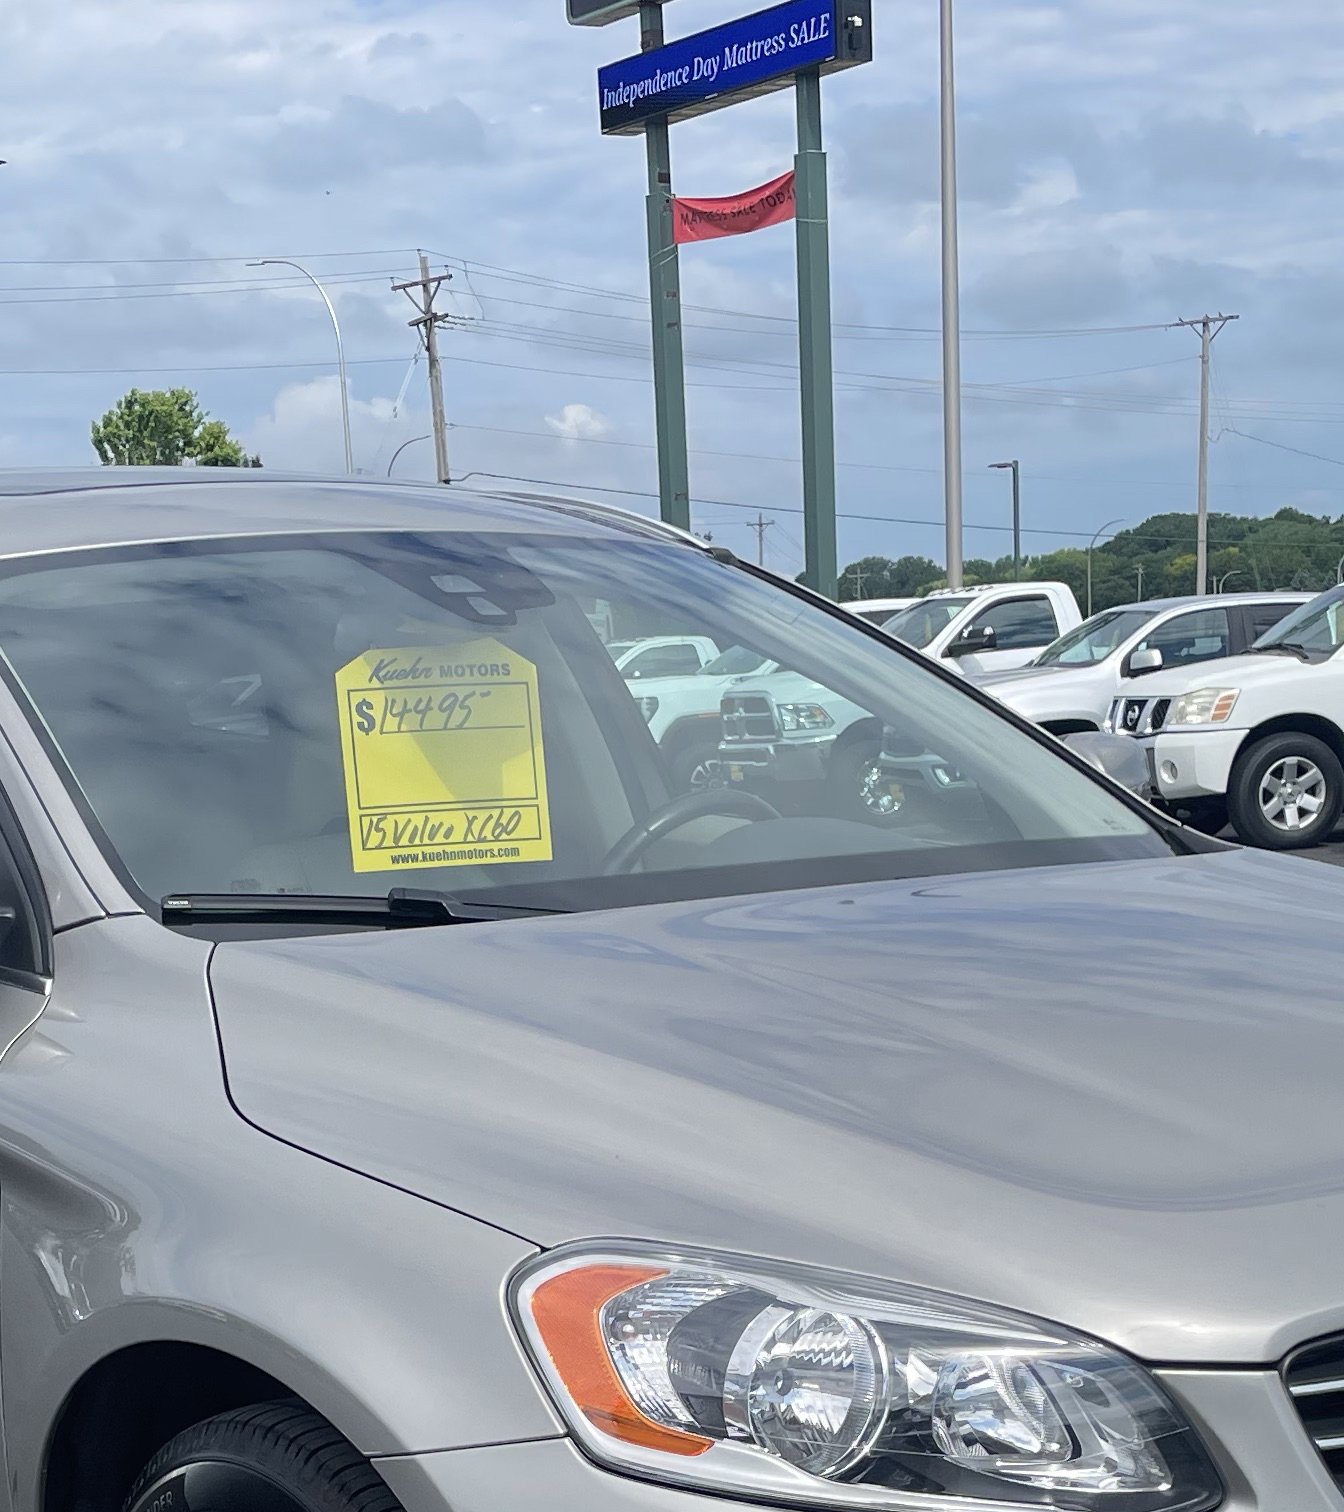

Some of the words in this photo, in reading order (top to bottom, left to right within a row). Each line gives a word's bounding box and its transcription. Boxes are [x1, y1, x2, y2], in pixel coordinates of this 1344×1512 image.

[603, 64, 690, 110] Independence
[692, 54, 720, 82] Day
[722, 31, 786, 71] Mattress
[788, 12, 830, 49] SALE
[368, 656, 433, 685] Kuehn
[439, 663, 511, 679] MOTORS
[394, 815, 455, 847] Volvo
[463, 808, 522, 842] XC60
[390, 846, 521, 866] www.kuehnmotors.com
